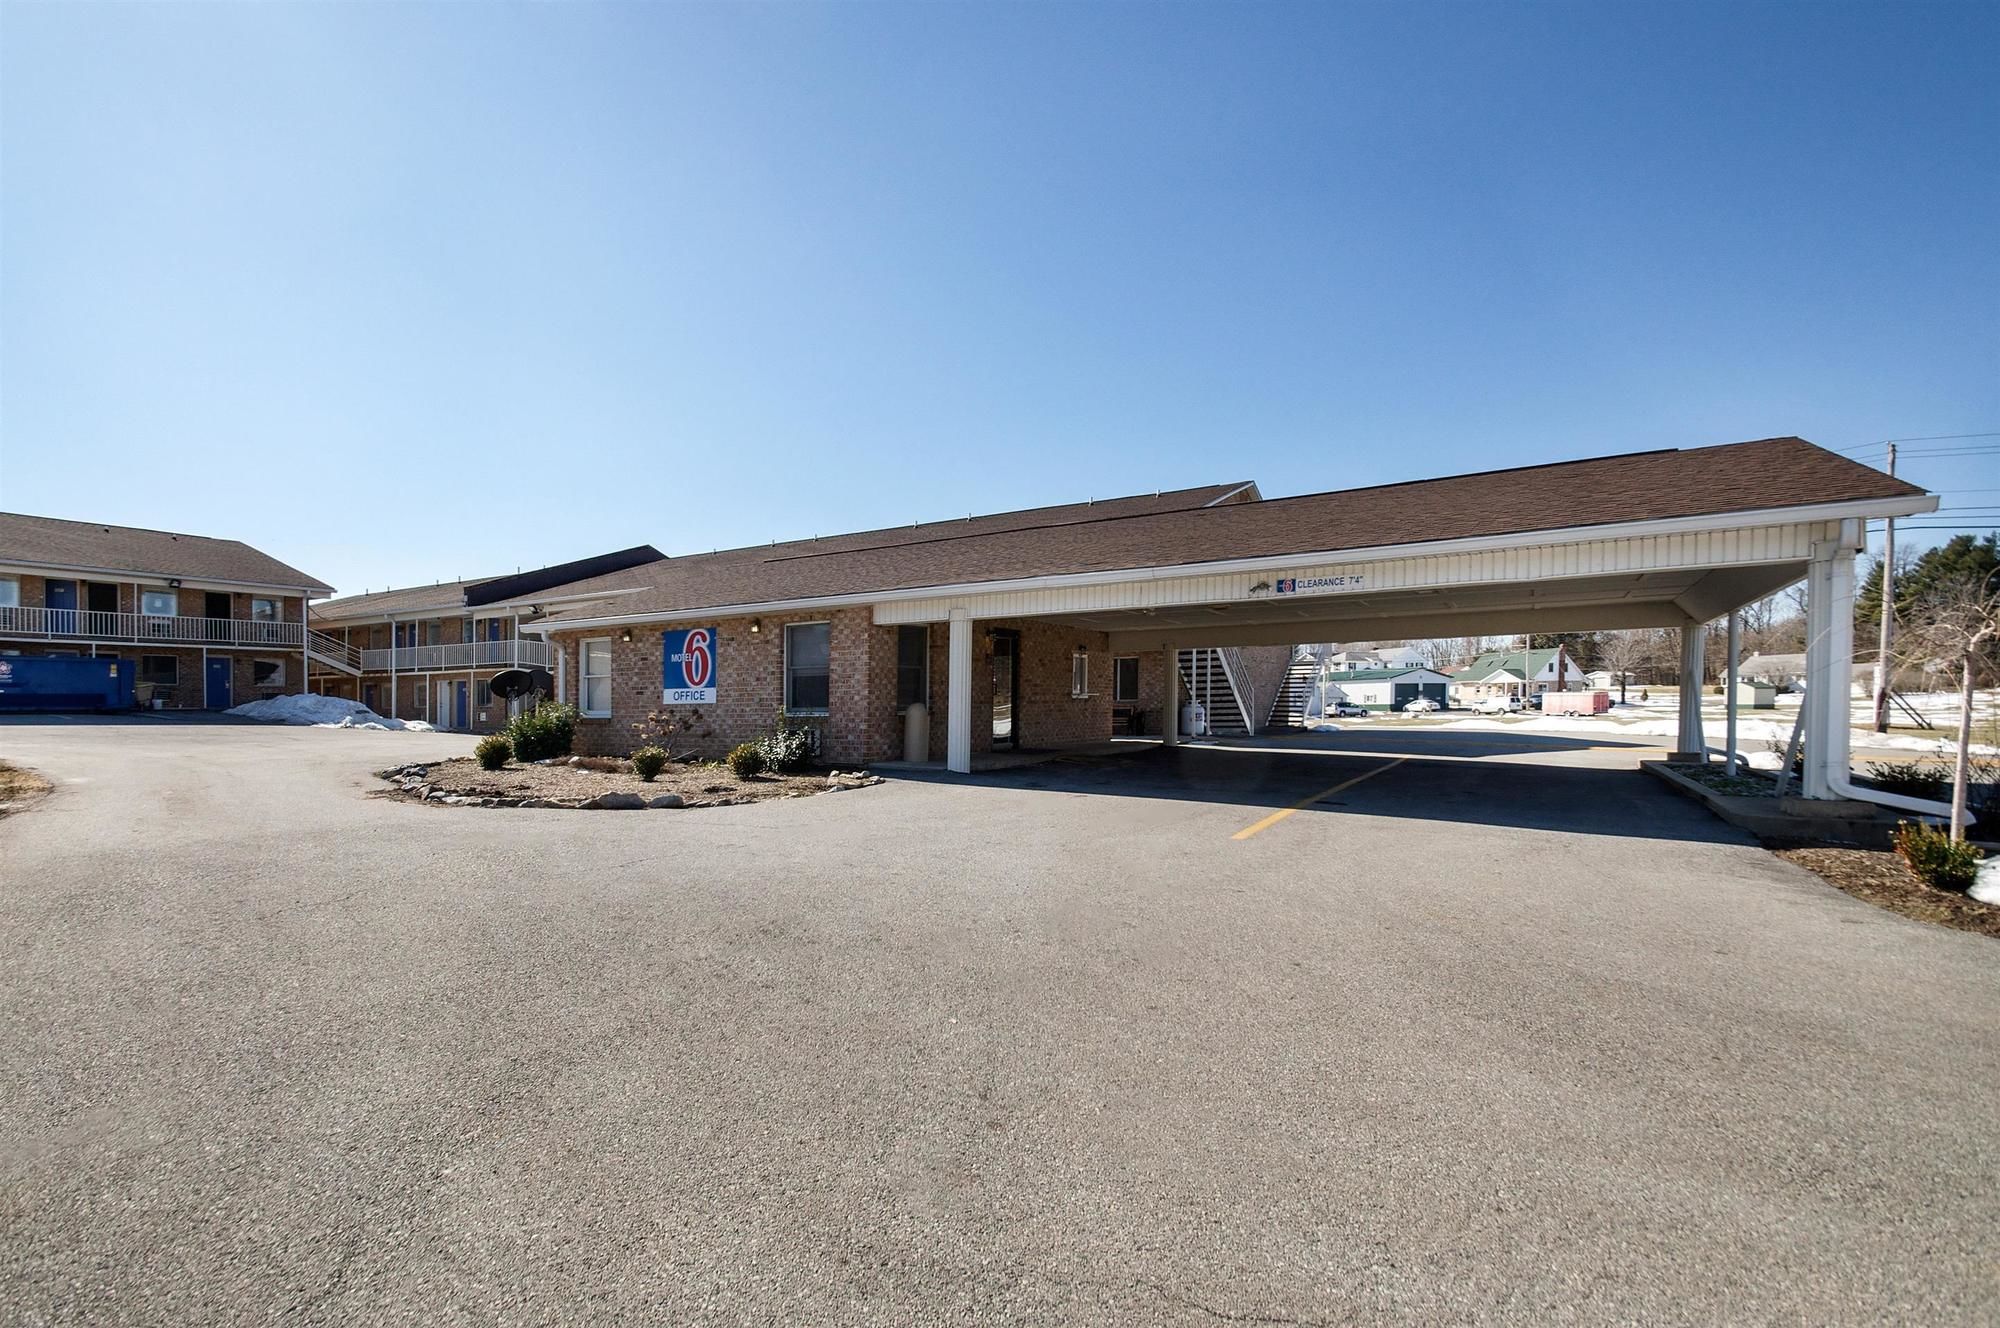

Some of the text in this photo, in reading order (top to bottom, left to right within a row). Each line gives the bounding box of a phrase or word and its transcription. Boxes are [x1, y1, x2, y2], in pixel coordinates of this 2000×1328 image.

[1282, 578, 1293, 592] 6
[1297, 577, 1344, 588] CLEARANCE
[671, 628, 712, 688] MOTEL 6
[673, 690, 705, 701] OFFICE
